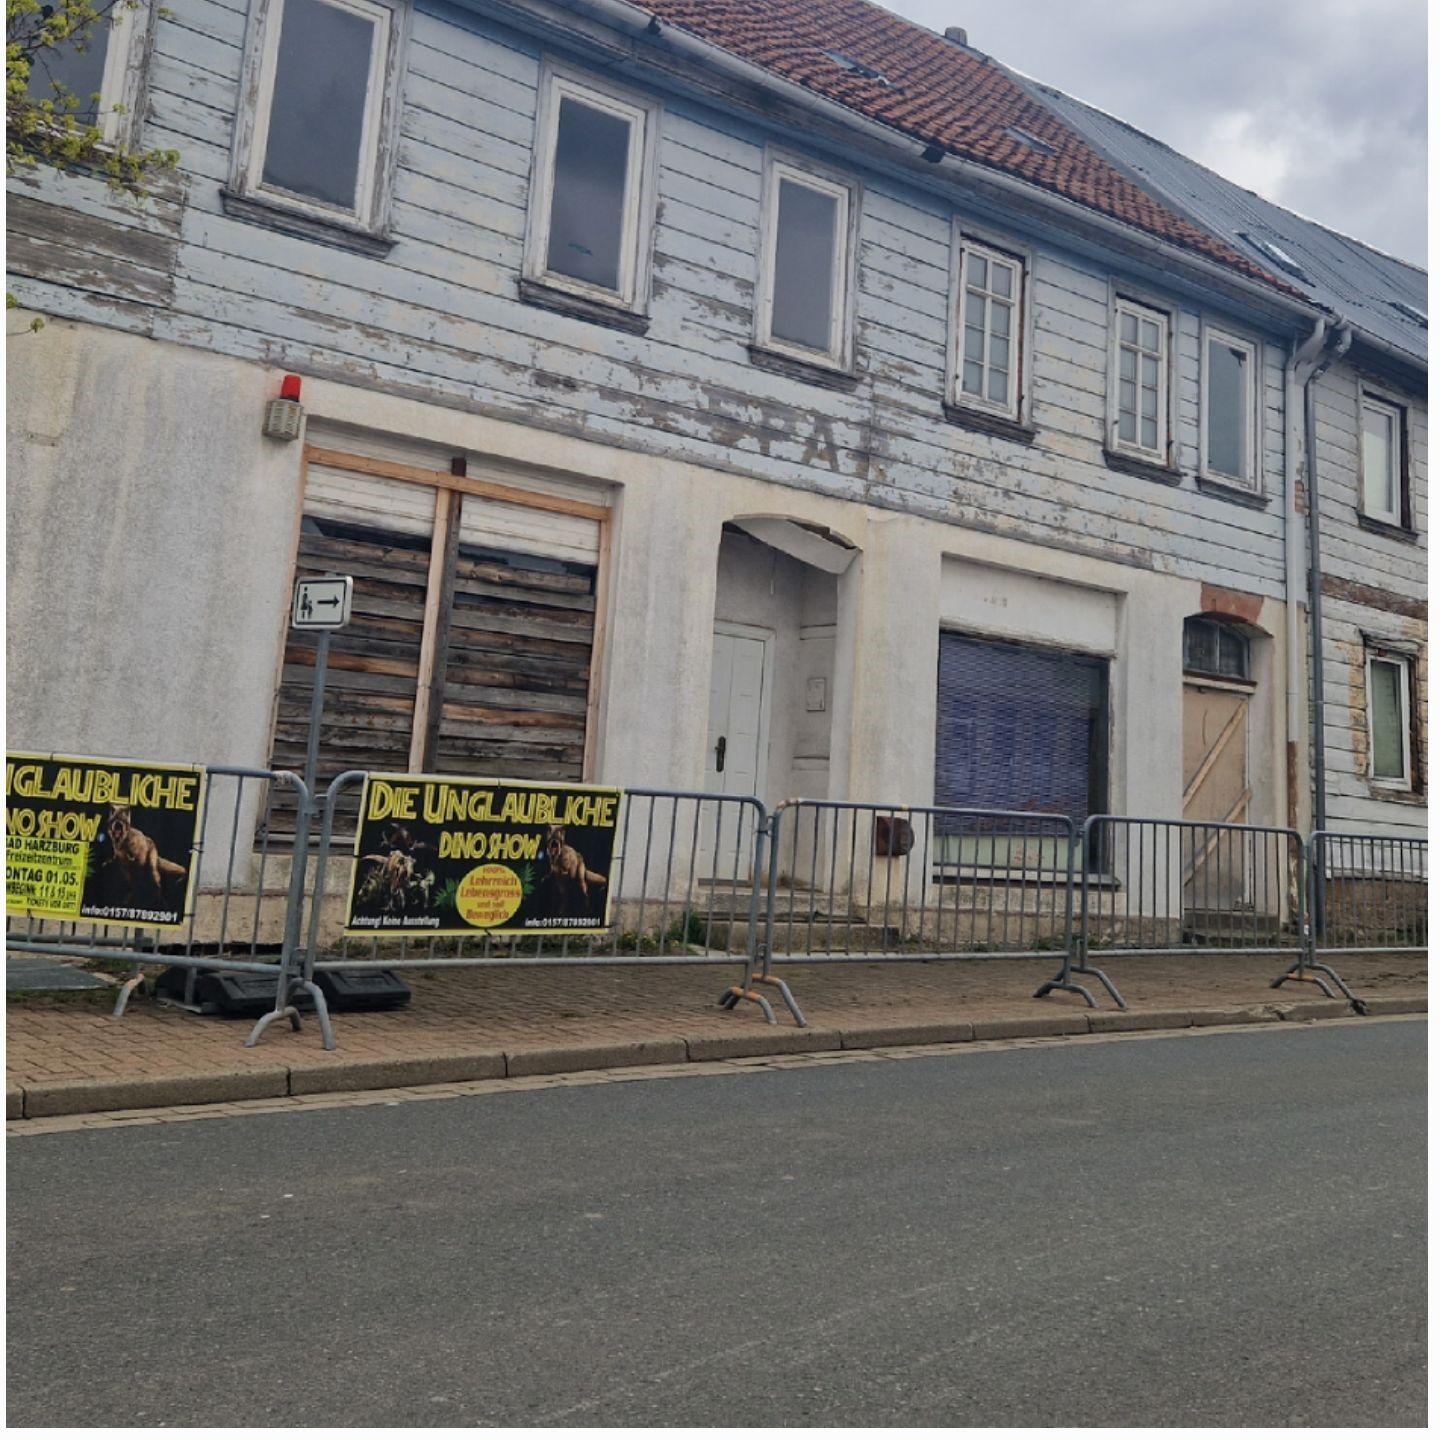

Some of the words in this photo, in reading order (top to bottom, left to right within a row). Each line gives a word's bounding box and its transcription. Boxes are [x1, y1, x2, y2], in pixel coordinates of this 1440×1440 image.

[368, 781, 420, 821] DIE
[423, 783, 617, 827] UNGLAUBLICHE
[25, 839, 79, 854] HARZBURG
